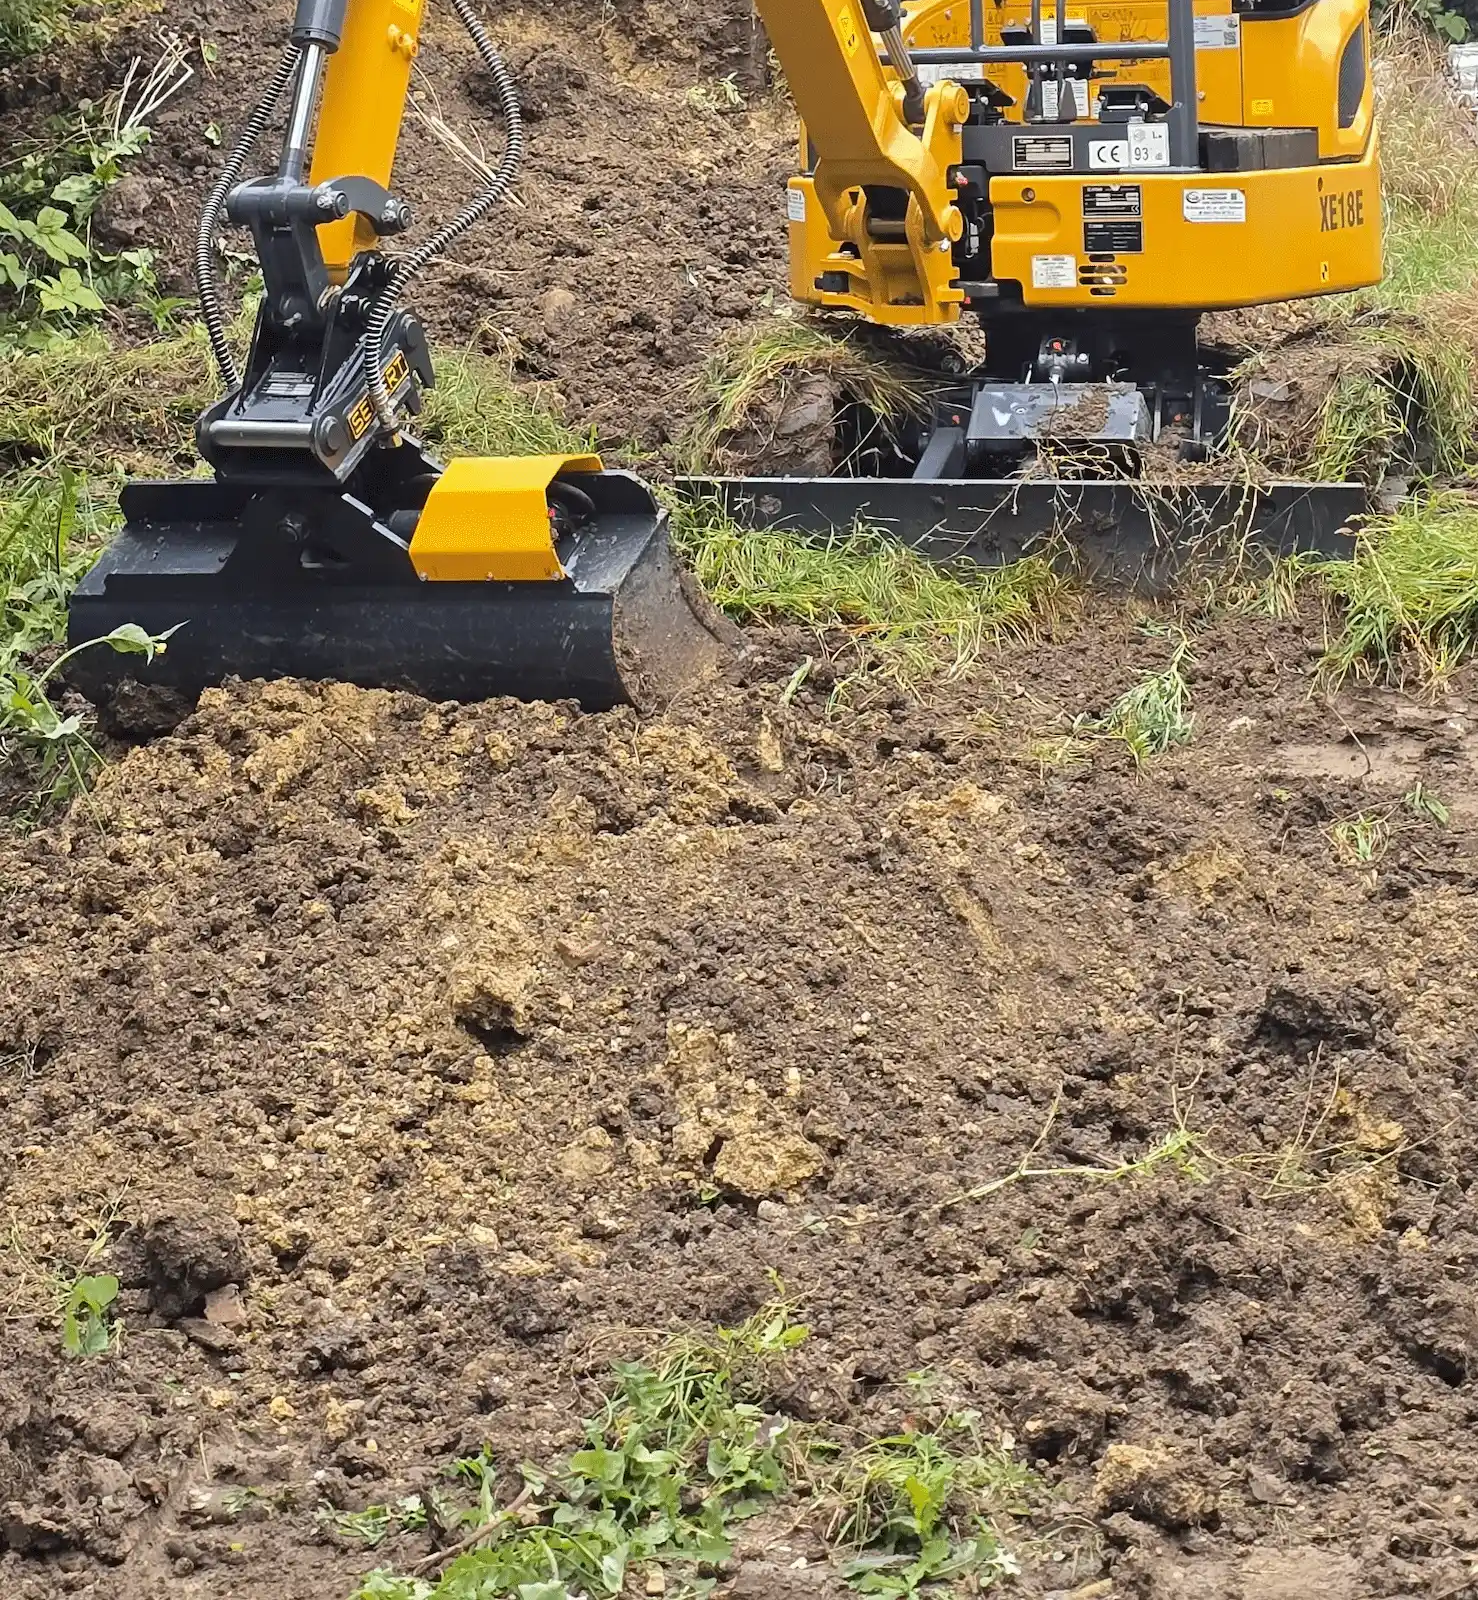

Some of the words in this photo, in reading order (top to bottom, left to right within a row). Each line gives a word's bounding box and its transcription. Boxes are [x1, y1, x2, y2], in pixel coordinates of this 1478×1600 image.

[1097, 145, 1120, 163] CE
[1134, 146, 1149, 161] 93
[1320, 189, 1364, 232] XE18E
